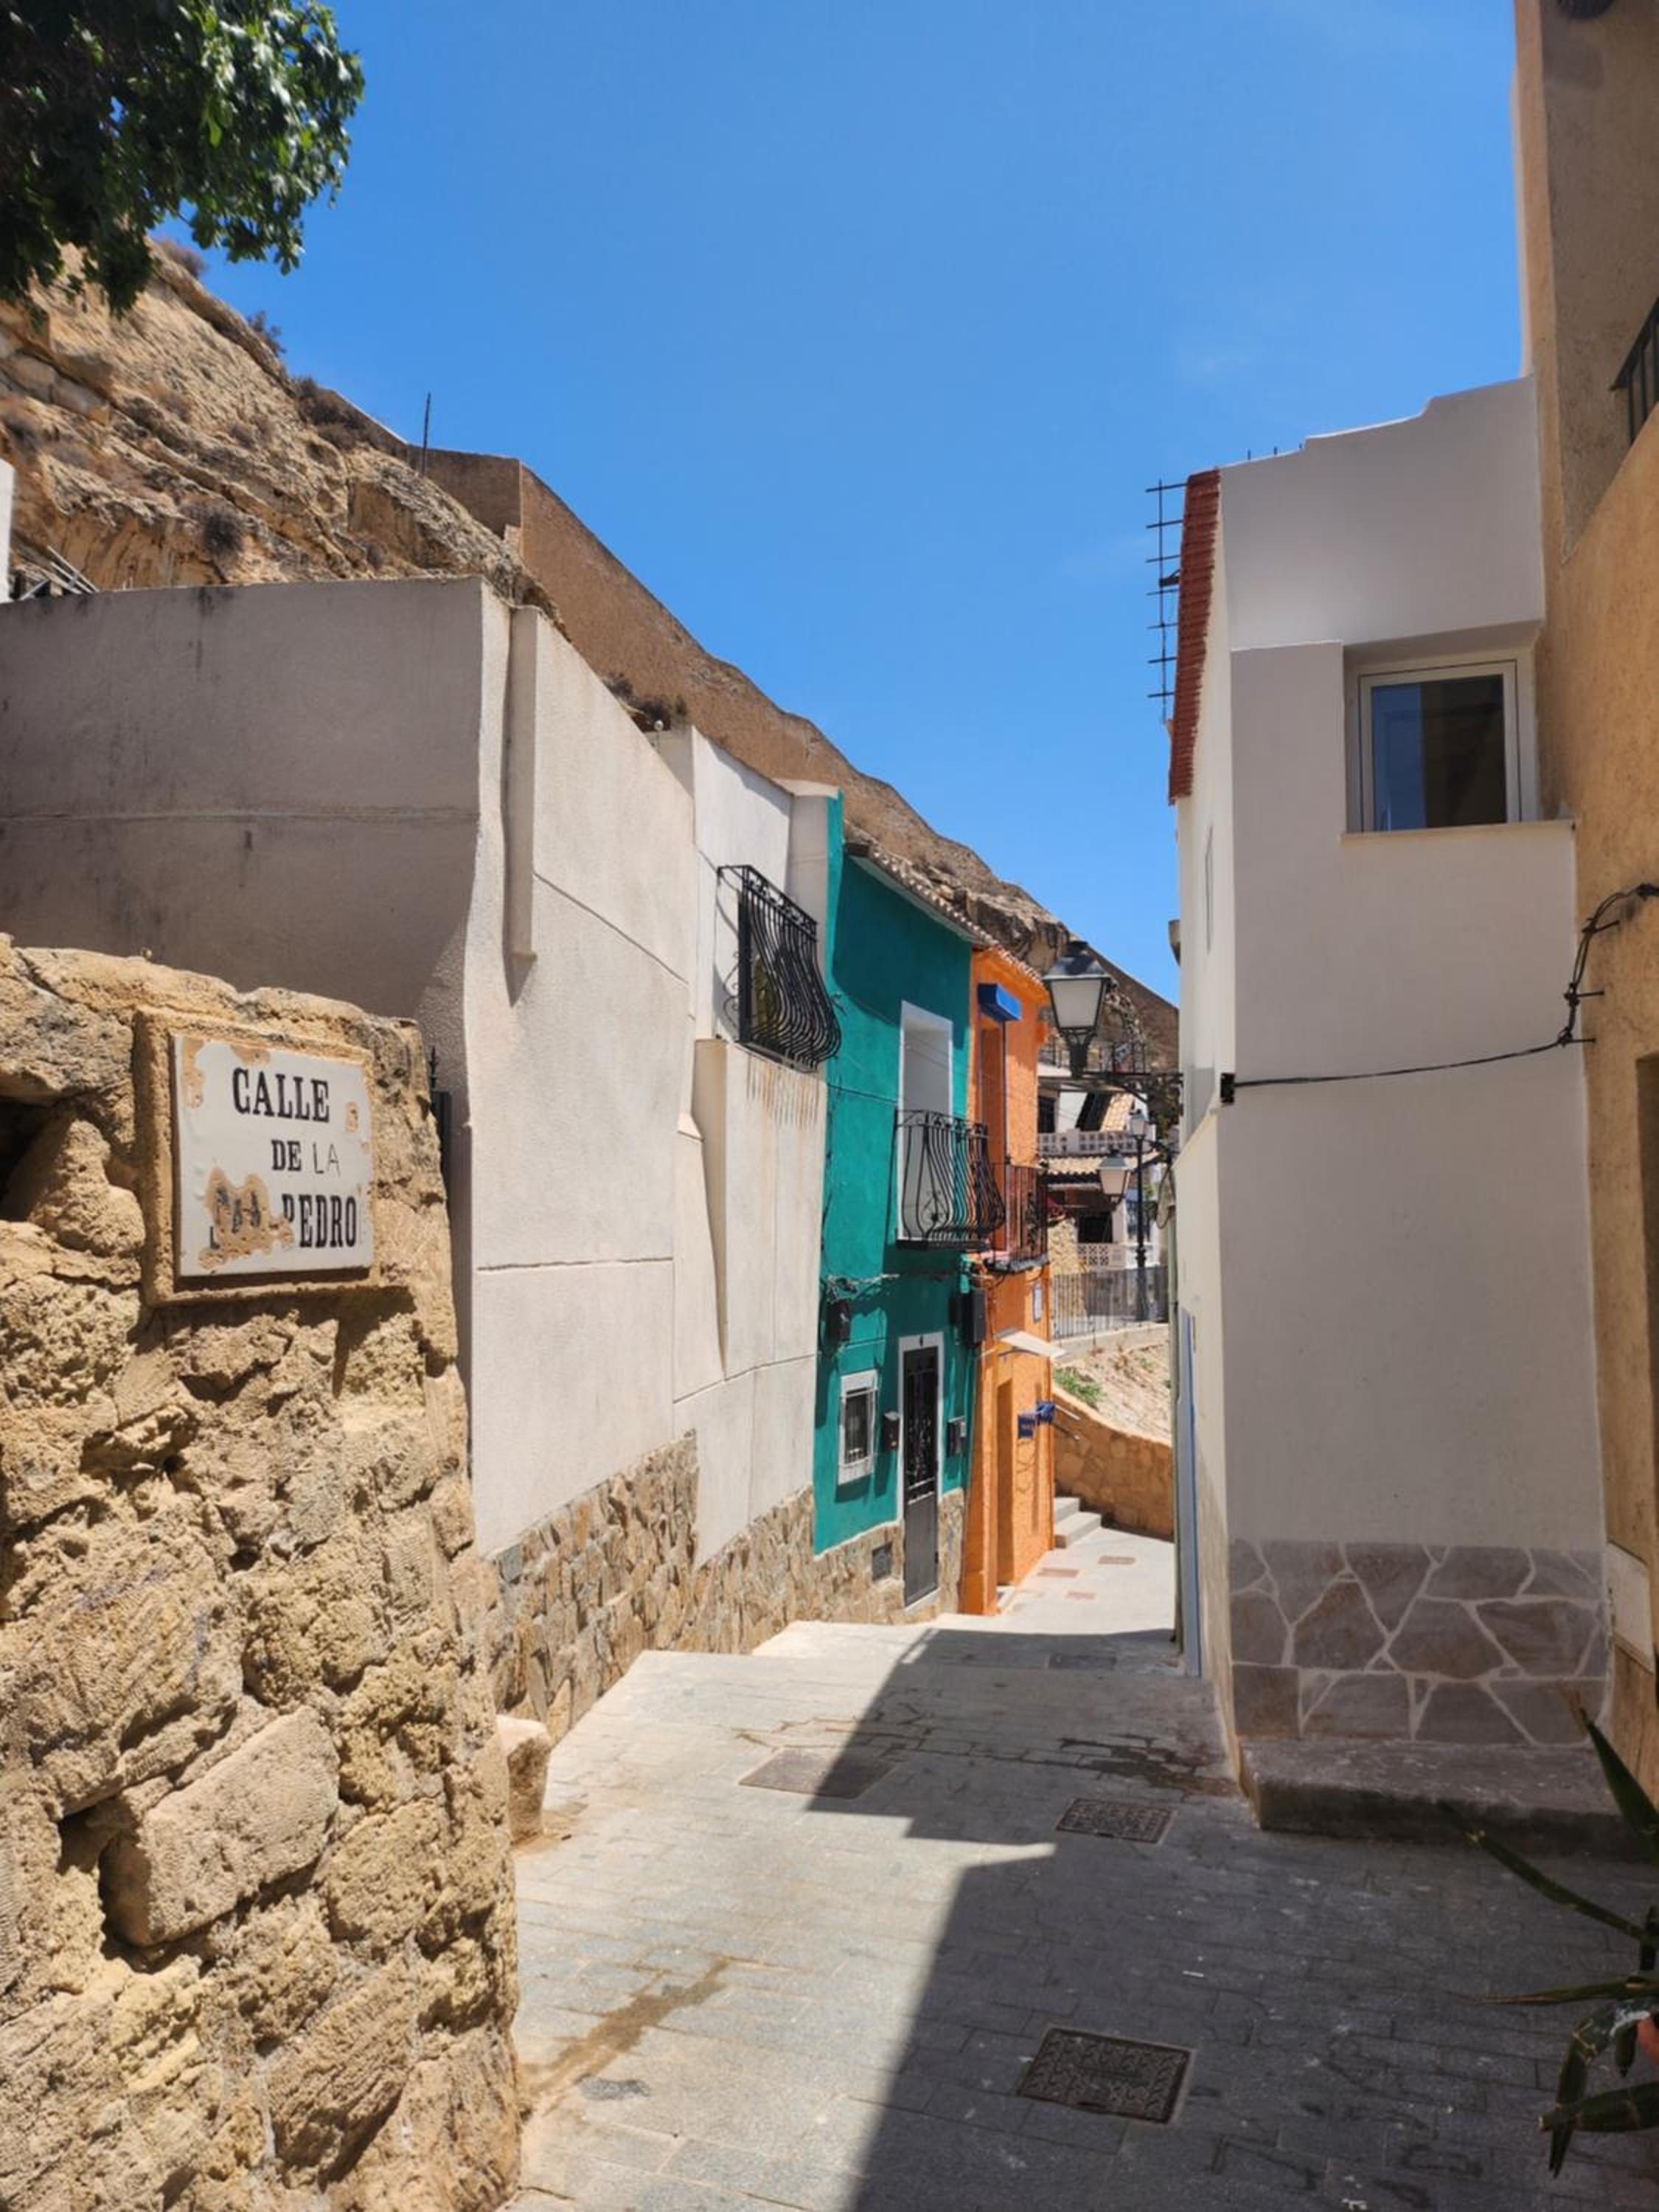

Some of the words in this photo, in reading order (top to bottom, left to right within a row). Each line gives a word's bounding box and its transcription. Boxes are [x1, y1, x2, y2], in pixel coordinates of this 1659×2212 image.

[233, 1068, 330, 1122] CALLE
[272, 1139, 301, 1171] DE
[313, 1144, 341, 1176] LA
